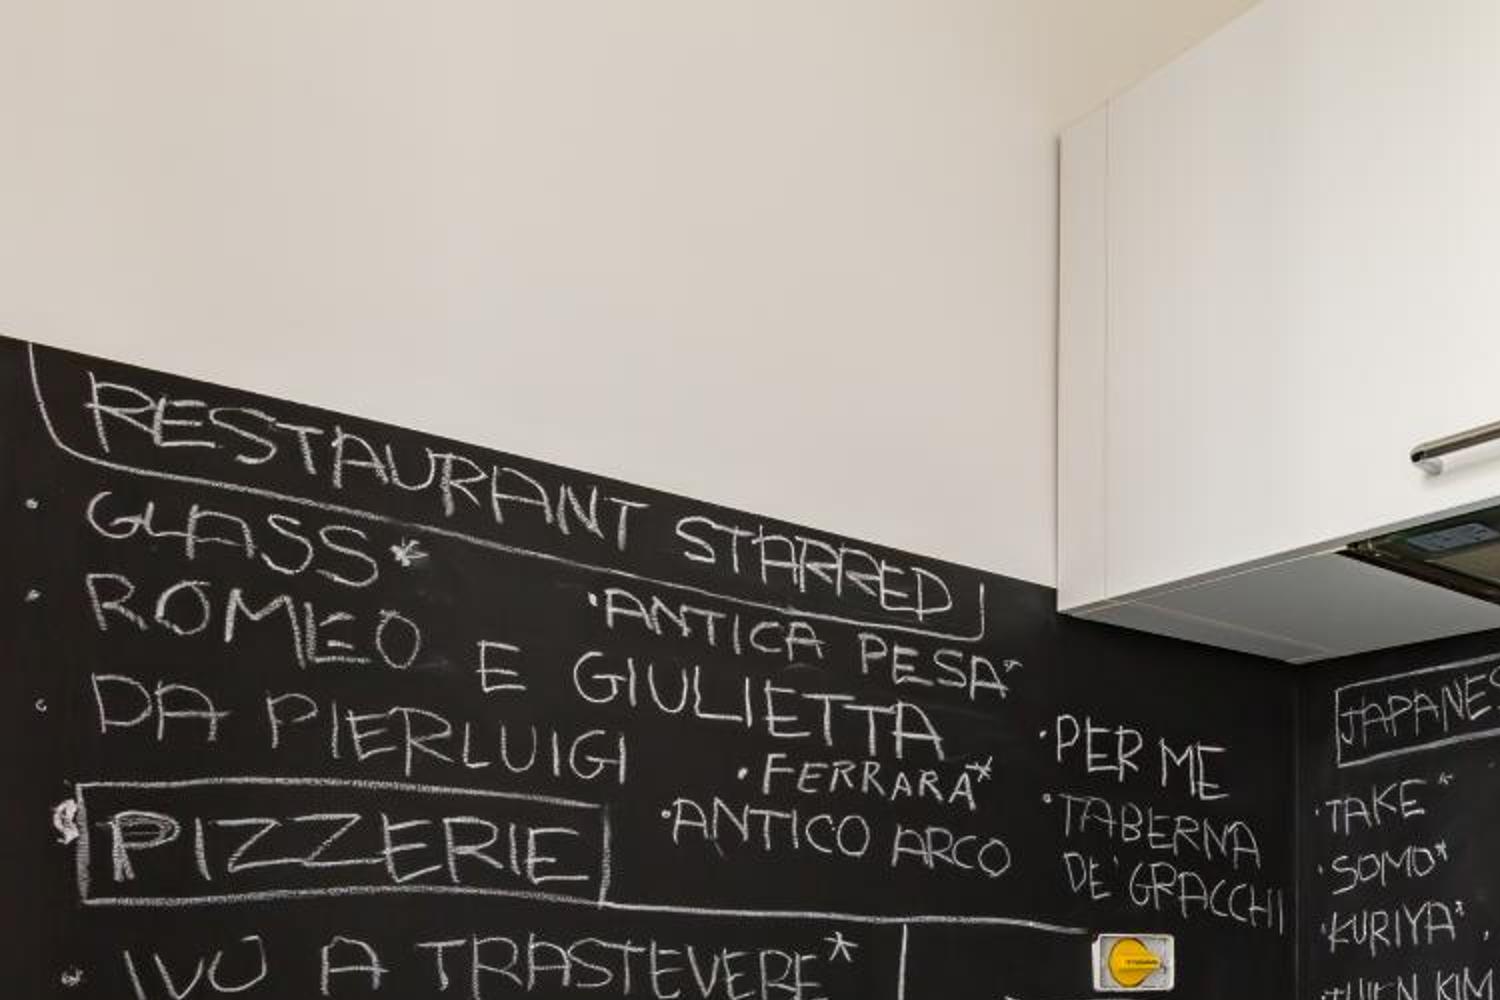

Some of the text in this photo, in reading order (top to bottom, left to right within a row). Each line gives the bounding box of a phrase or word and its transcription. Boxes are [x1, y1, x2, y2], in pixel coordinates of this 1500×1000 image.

[84, 371, 953, 621] RESTAURANT STARRED
[88, 492, 379, 588] GLASS
[87, 573, 945, 760] ROMEO E GIULIETTA
[604, 588, 1009, 700] ANTICA PESA
[91, 672, 627, 784] DA PIERLUIGI
[1057, 714, 1230, 800] PER ME
[762, 753, 977, 811] FERRARA
[1325, 779, 1428, 835] TAKE
[98, 810, 589, 885] PIZZERIE
[672, 797, 1012, 877] ANTICO ARCO
[1057, 793, 1262, 870] TABERNA
[1129, 861, 1285, 936] GRACCHI
[1331, 847, 1437, 895] SOMO
[321, 935, 389, 995] A
[1328, 903, 1456, 957] KURIYA
